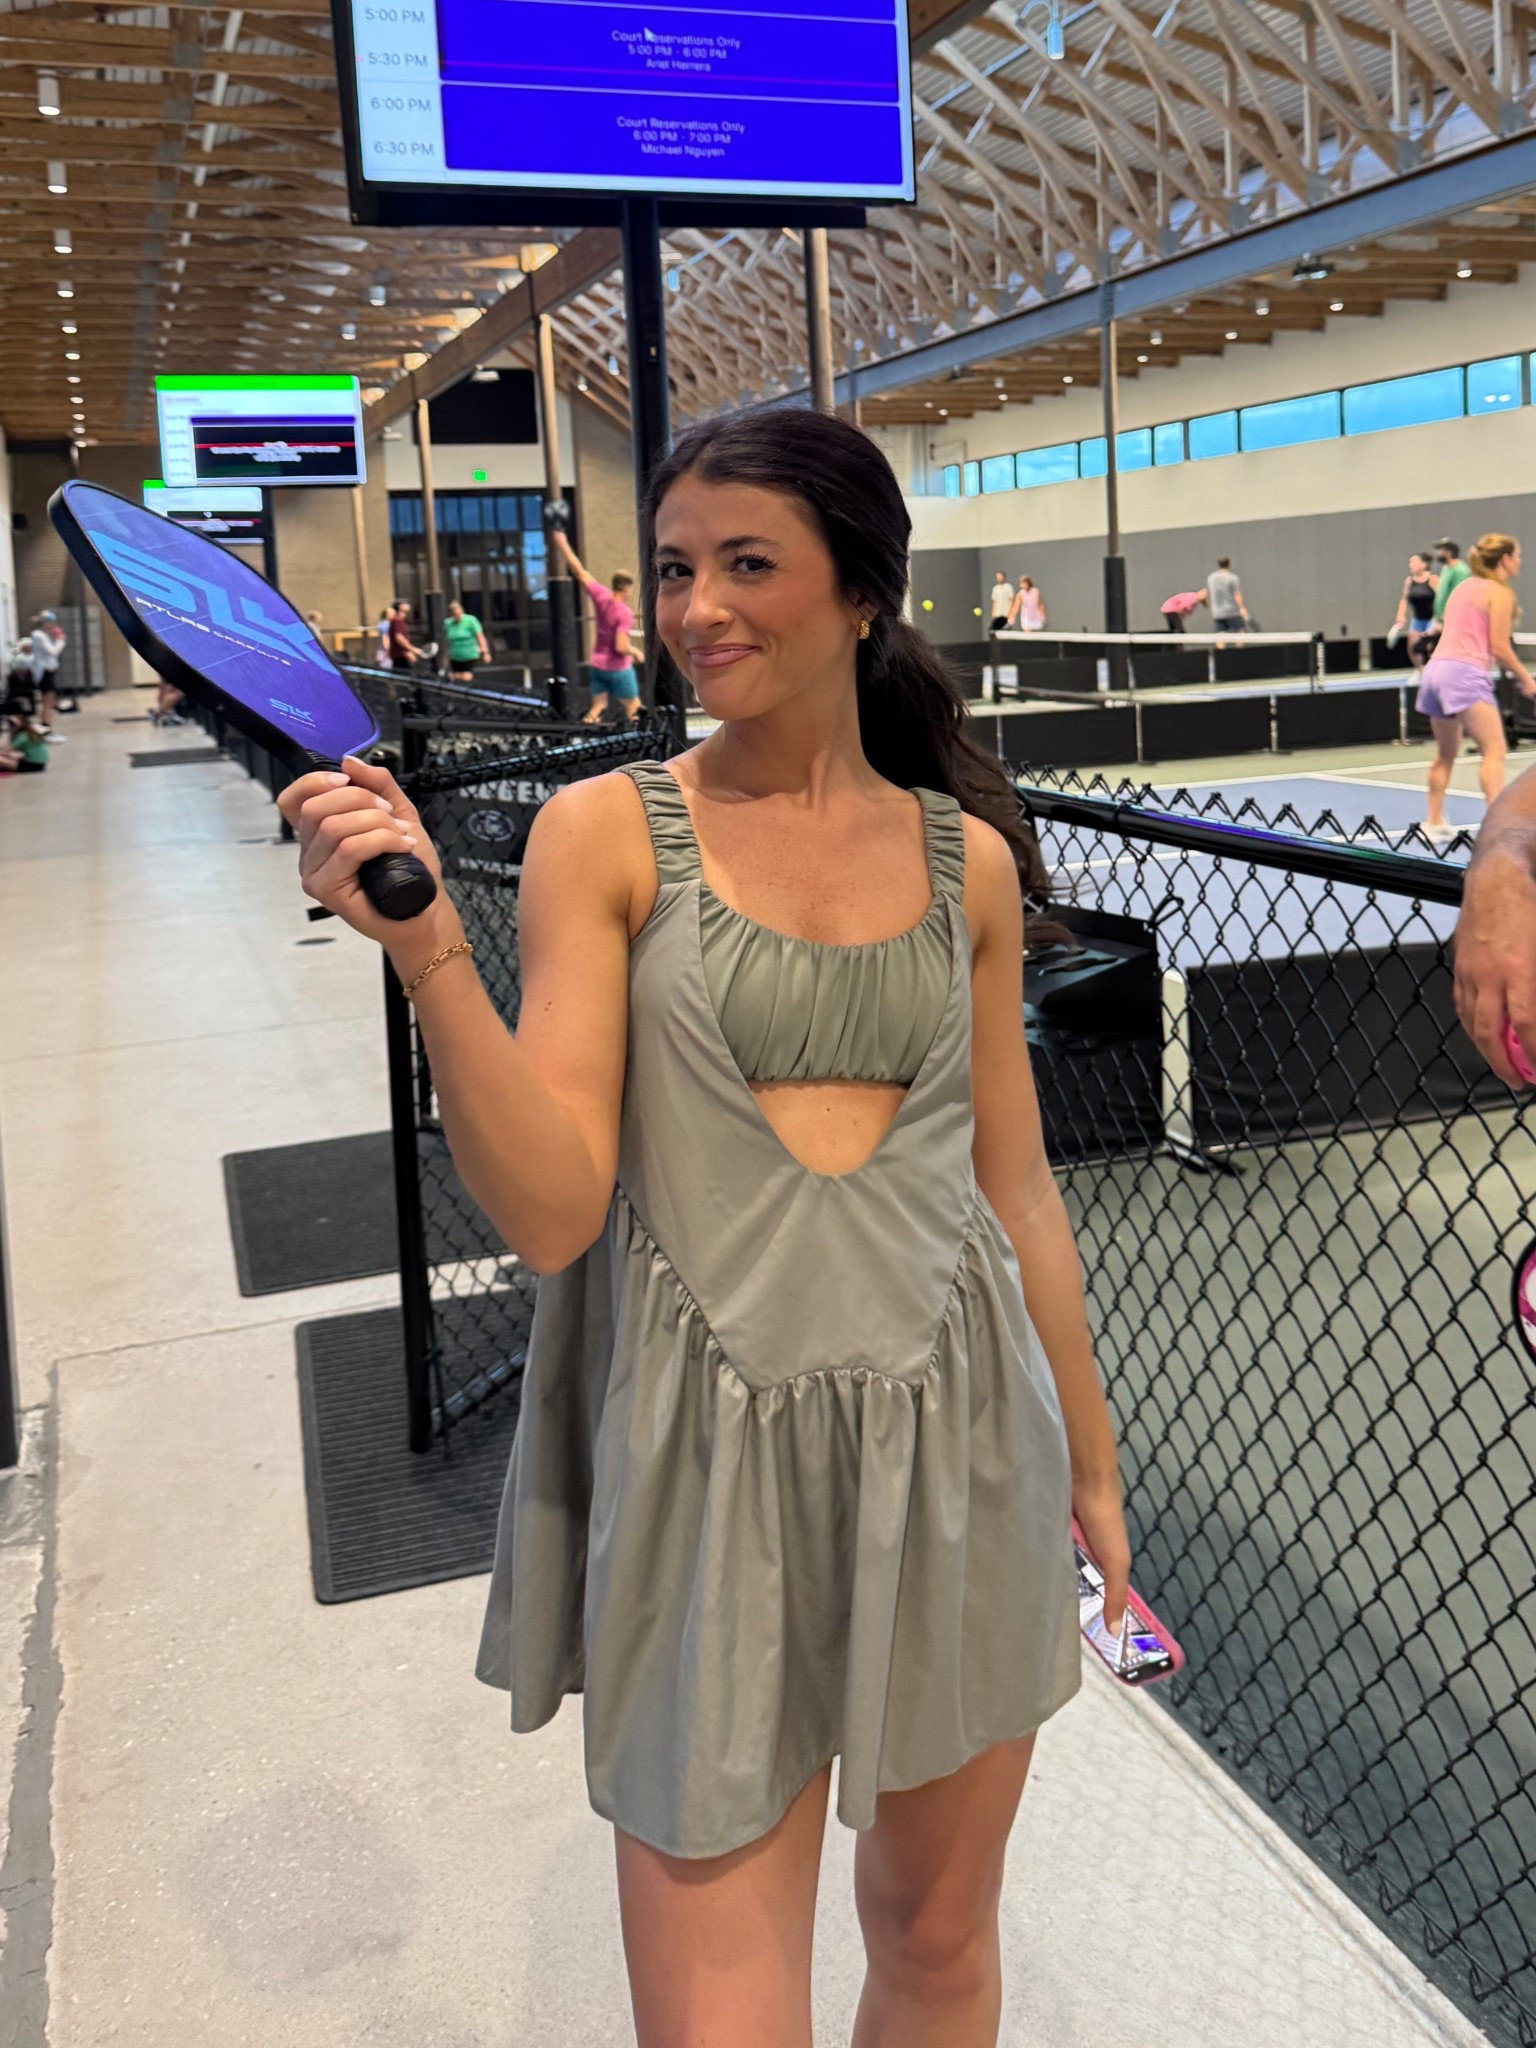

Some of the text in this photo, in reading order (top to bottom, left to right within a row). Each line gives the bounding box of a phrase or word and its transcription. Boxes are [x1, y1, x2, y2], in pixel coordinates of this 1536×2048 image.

[365, 7, 426, 23] 5:00 PM
[611, 30, 643, 43] Court
[716, 36, 741, 50] Only
[368, 50, 429, 67] 5:30 PM
[654, 45, 673, 57] PM
[709, 48, 728, 60] PM
[370, 96, 432, 112] 6:00 PM
[616, 116, 746, 135] Court Reservations Only
[660, 131, 679, 142] PM
[713, 133, 732, 145] PM
[373, 141, 435, 156] 6:30 PM
[640, 143, 726, 159] Michael Nguyen
[135, 597, 211, 633] ATLAS
